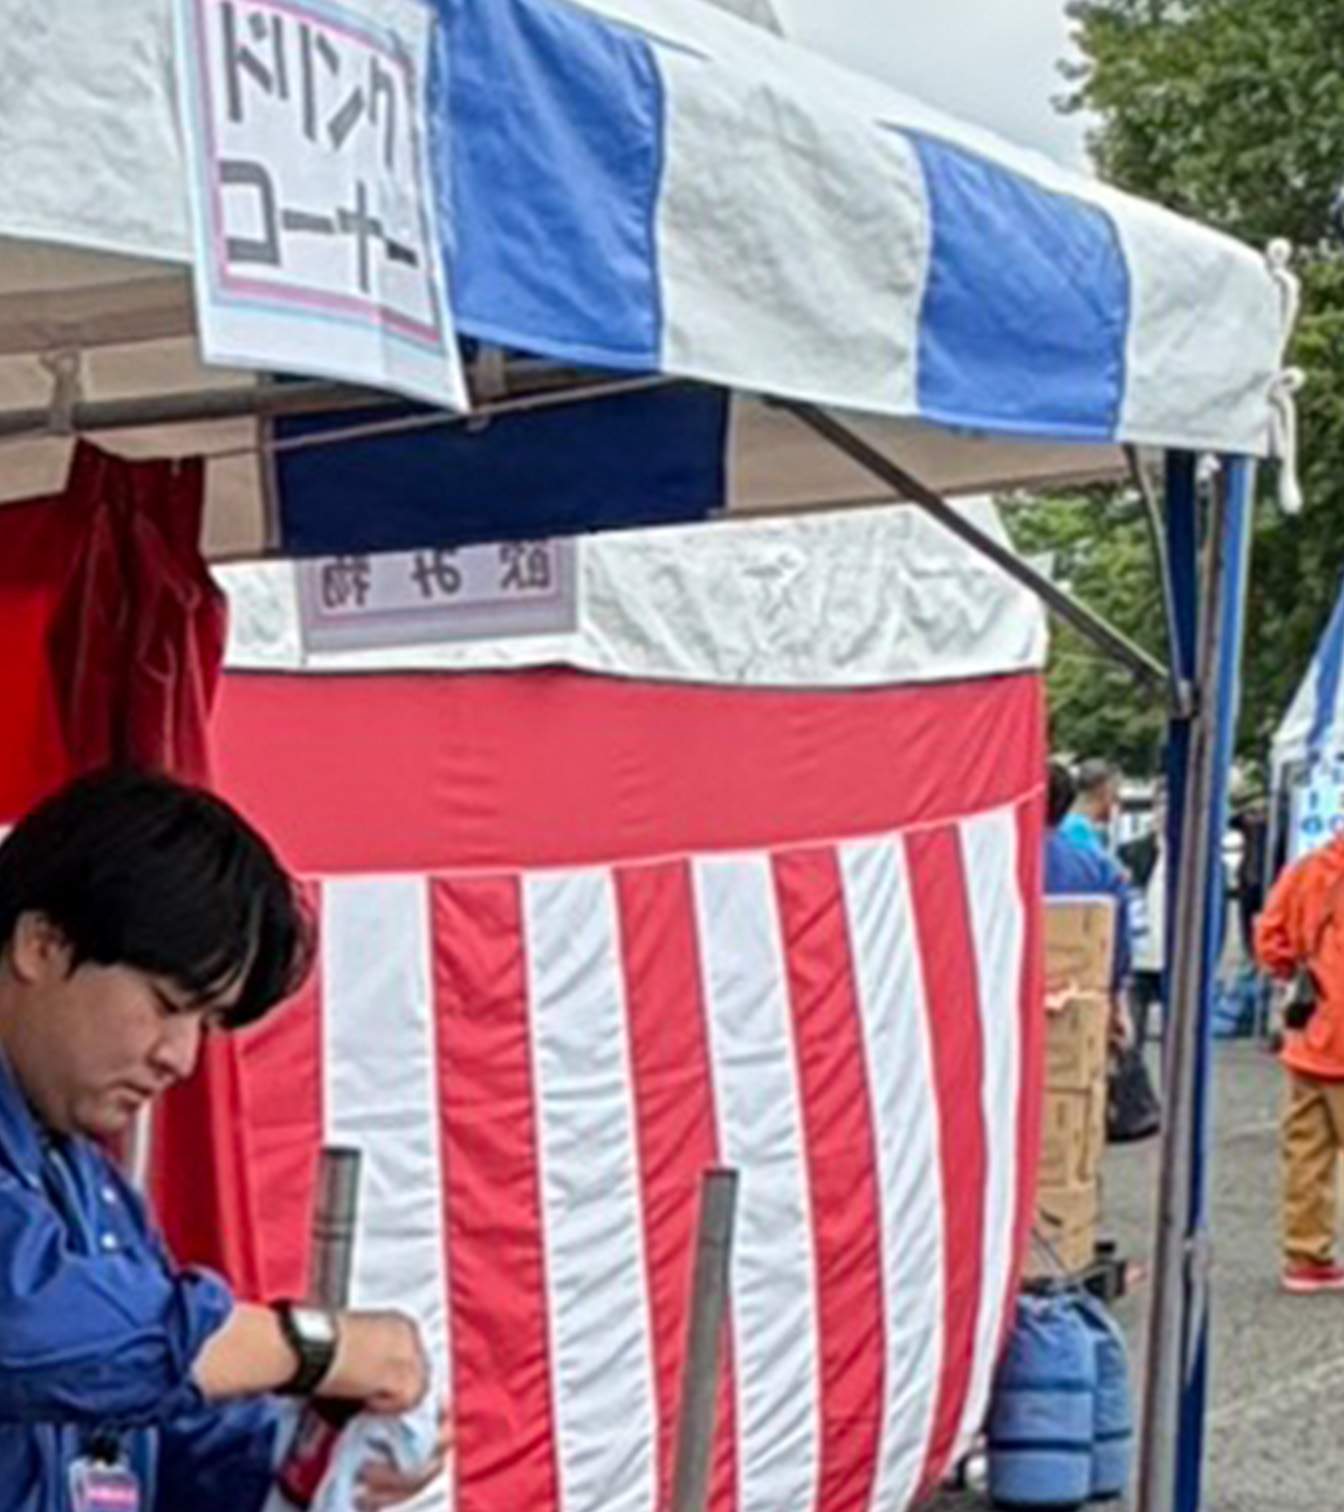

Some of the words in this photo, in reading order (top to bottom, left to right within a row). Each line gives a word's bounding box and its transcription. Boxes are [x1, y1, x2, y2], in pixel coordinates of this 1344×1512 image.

[221, 2, 398, 168] ドリンク
[219, 159, 418, 293] コーナー
